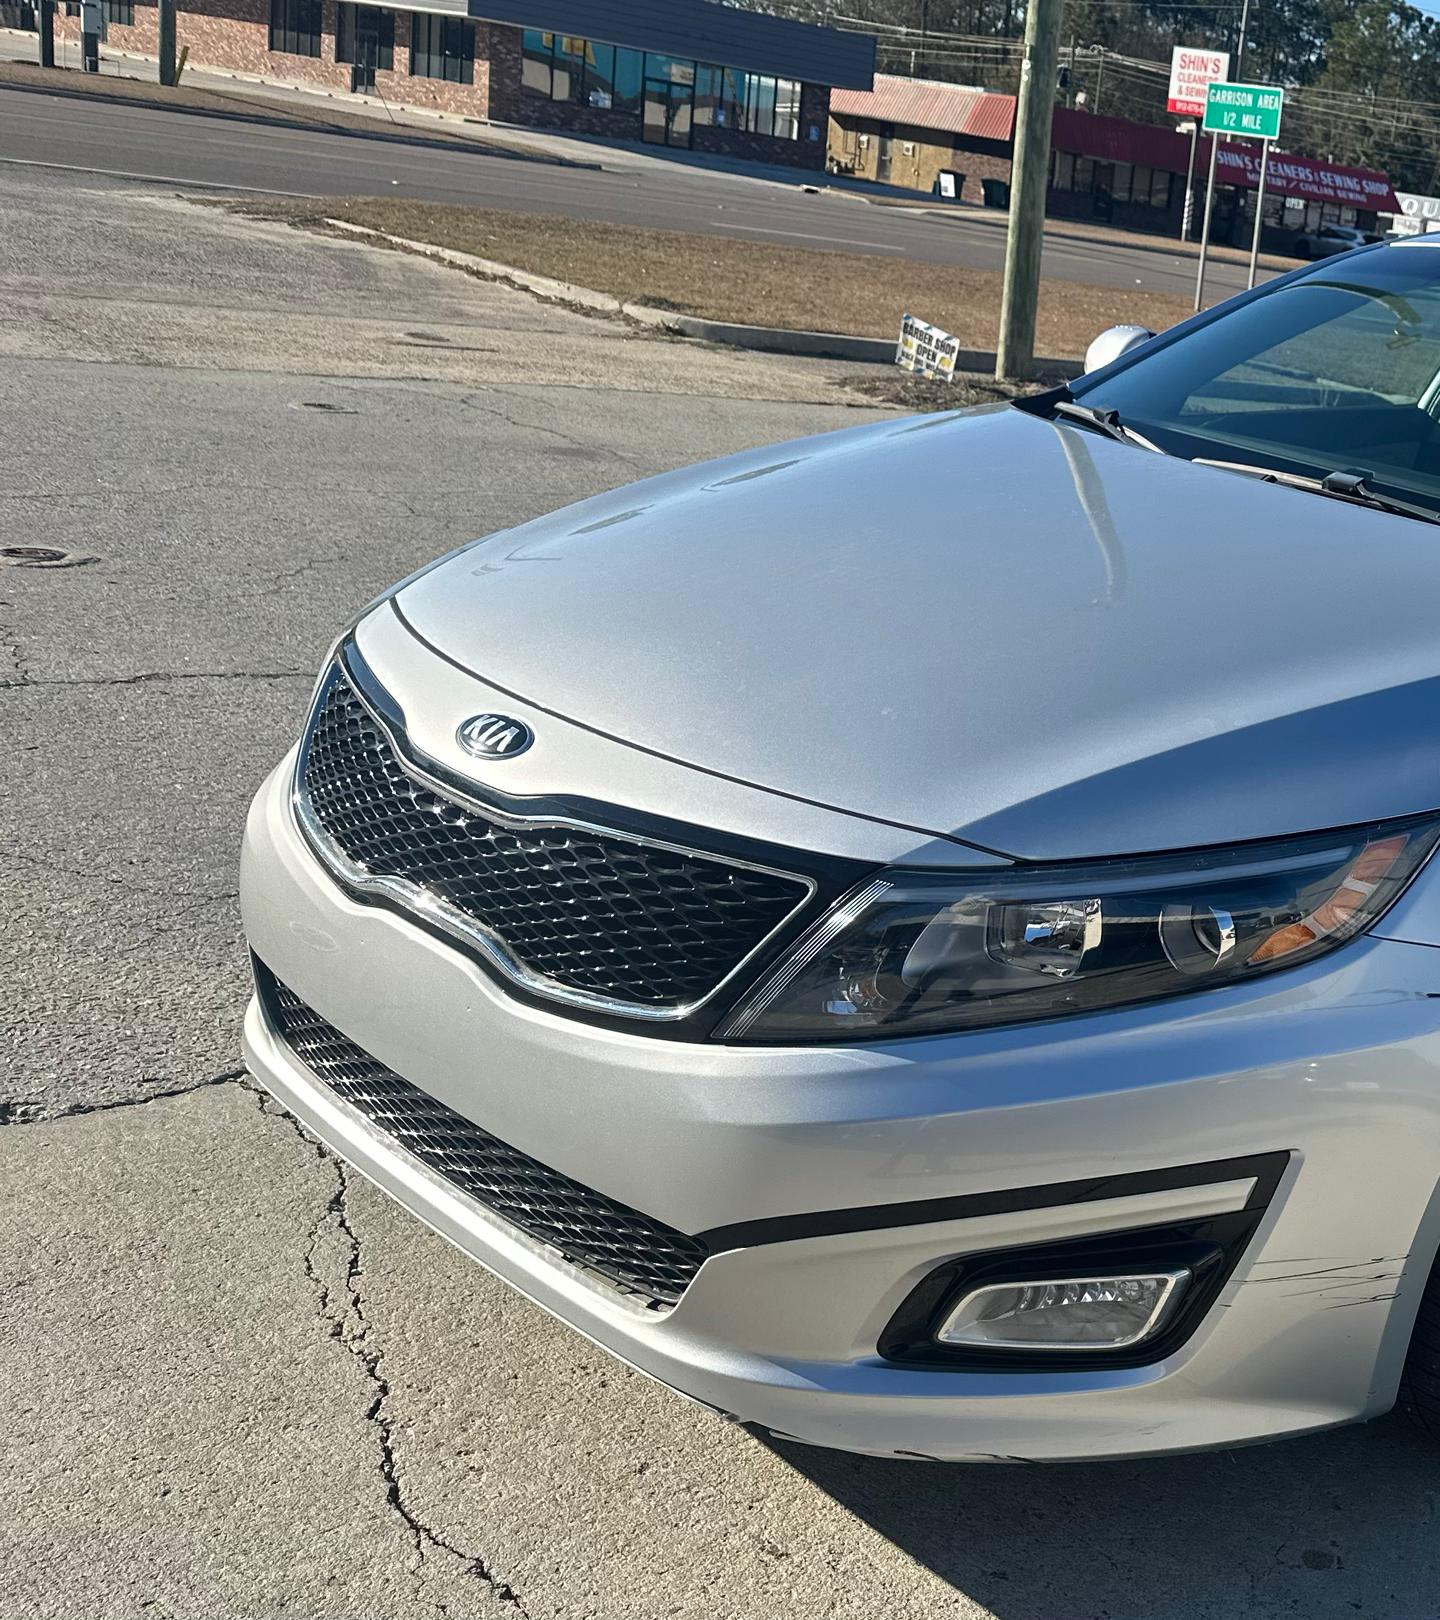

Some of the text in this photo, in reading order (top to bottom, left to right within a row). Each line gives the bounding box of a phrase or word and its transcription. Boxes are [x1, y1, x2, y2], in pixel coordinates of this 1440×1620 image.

[1179, 53, 1221, 74] SHIN'S
[1209, 89, 1280, 110] GARRISON AREA
[1223, 111, 1263, 130] 1/2 MILE
[1217, 150, 1253, 170] SHIN'S
[1320, 171, 1361, 192] SEWING
[1362, 180, 1389, 197] SHOP
[902, 322, 956, 358] BARBER SHOP
[916, 344, 938, 363] OPEN
[463, 714, 520, 752] KIA
